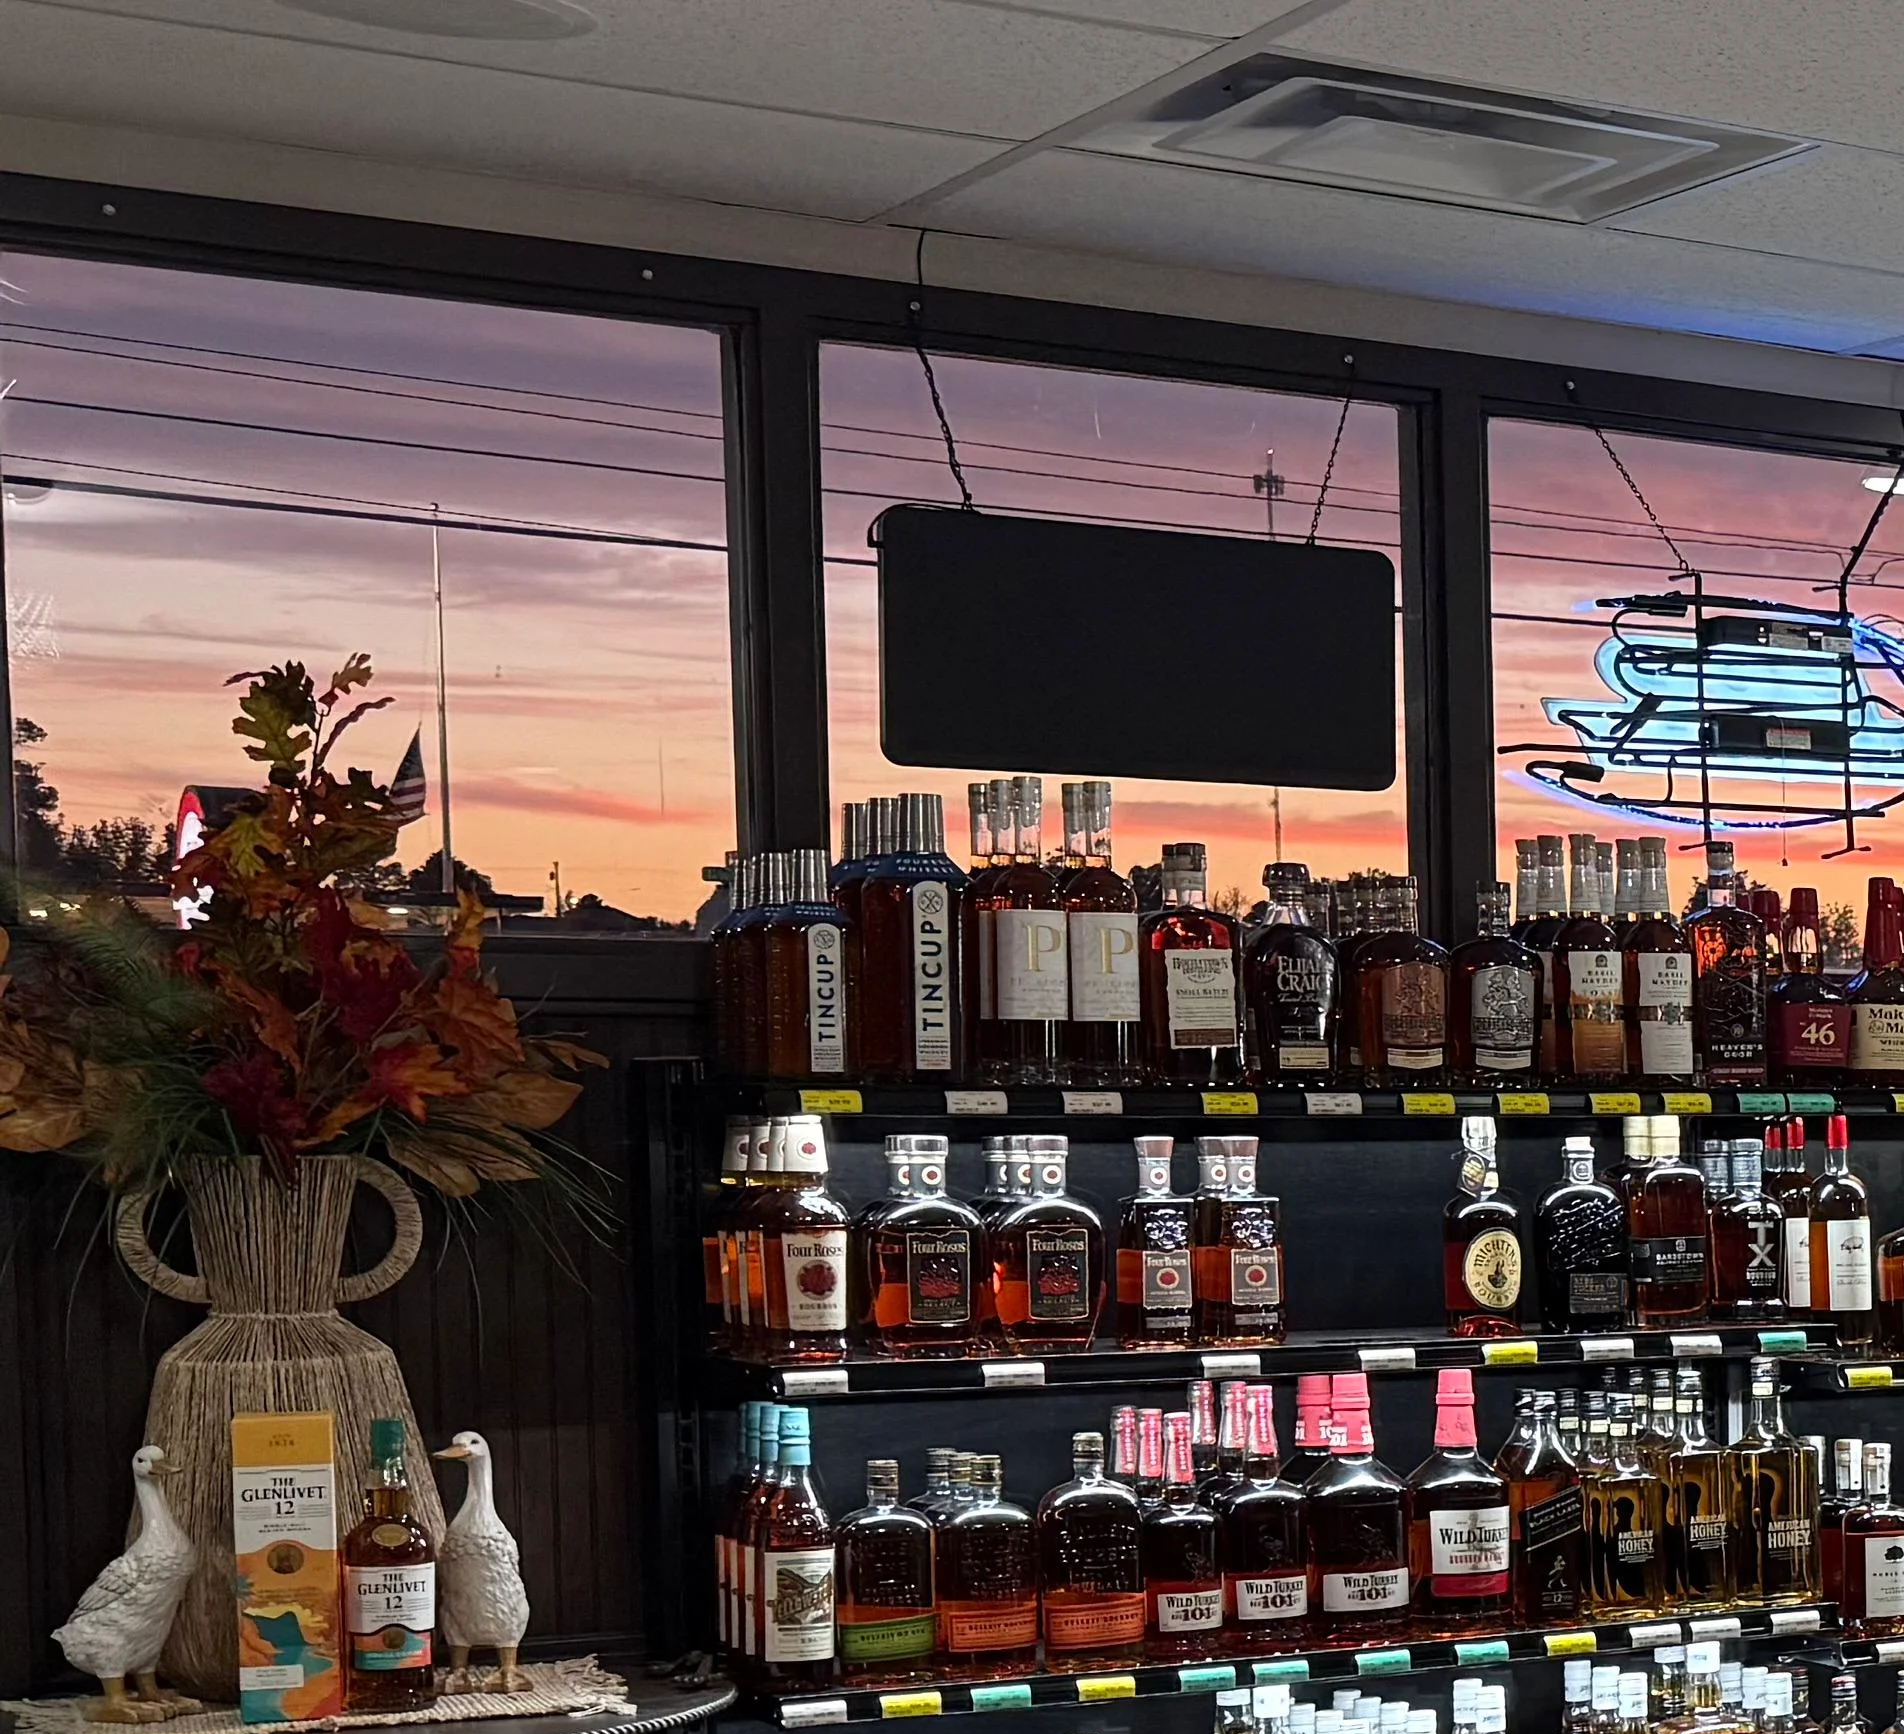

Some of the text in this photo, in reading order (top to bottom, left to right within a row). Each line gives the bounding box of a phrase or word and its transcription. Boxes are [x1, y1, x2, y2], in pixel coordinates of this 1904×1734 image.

[1023, 921, 1061, 972] P
[1101, 928, 1134, 973] P
[920, 920, 944, 1031] TINCUP
[816, 954, 837, 1042] TINCUP
[1801, 1022, 1835, 1045] 46
[787, 1243, 845, 1256] Four Roses
[913, 1240, 966, 1252] Four Roses
[1033, 1239, 1085, 1251] Four Roses
[270, 1477, 296, 1487] THE
[241, 1486, 326, 1502] GLENLIVET
[274, 1501, 295, 1516] 12
[1691, 1514, 1727, 1524] AMERICAN
[1768, 1519, 1810, 1531] AMERICAN
[1440, 1528, 1476, 1544] WILD
[1619, 1531, 1654, 1540] AMERICAN
[1691, 1523, 1727, 1539] HONEY
[1619, 1538, 1654, 1553] HONEY
[1768, 1531, 1811, 1547] HONEY
[381, 1573, 404, 1582] THE
[1343, 1575, 1398, 1588] WILD TURKEY
[358, 1580, 427, 1596] GLENLIVET
[1245, 1581, 1271, 1594] WILD
[1358, 1586, 1389, 1600] 101
[384, 1595, 403, 1610] 12
[1167, 1596, 1192, 1608] WILD
[1262, 1594, 1294, 1607] 101
[1182, 1607, 1213, 1621] 101
